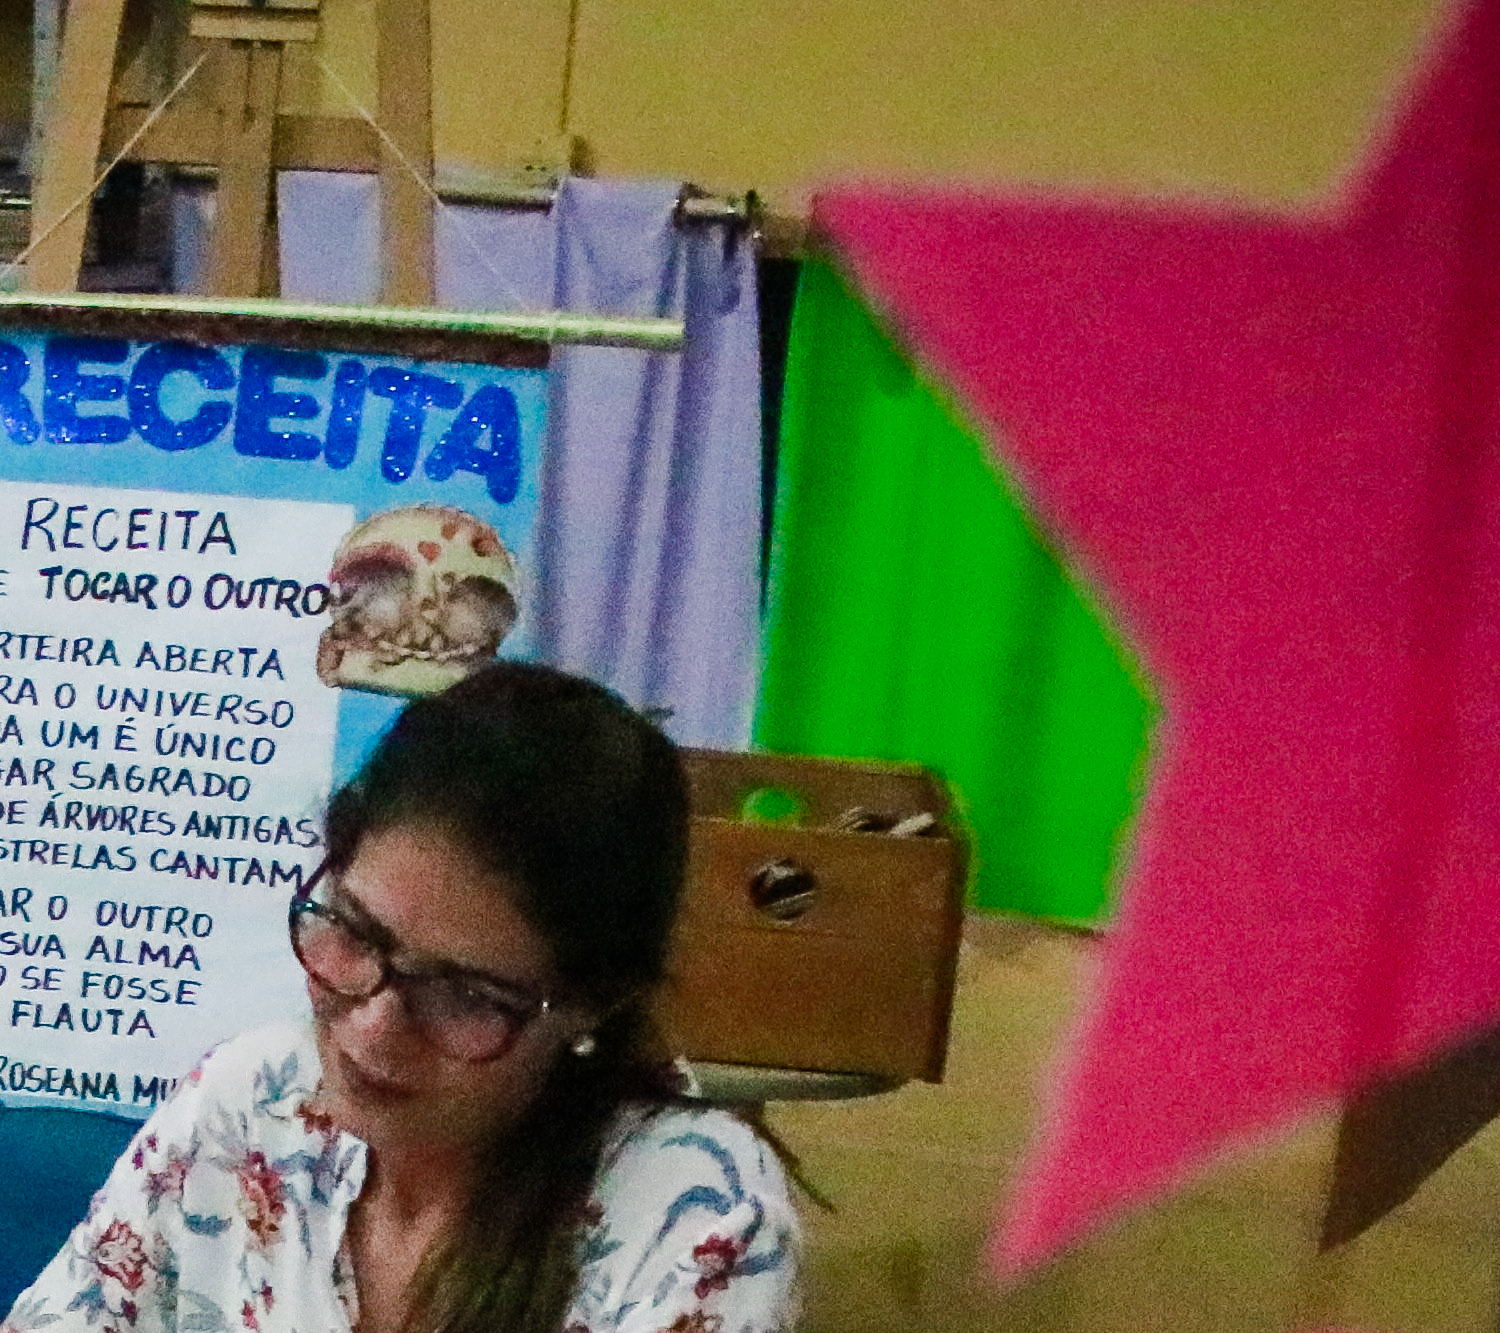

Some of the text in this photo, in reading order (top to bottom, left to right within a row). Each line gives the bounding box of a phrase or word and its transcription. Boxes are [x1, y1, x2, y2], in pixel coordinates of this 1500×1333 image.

[21, 497, 237, 555] RECEITA
[39, 566, 158, 610] TOCAR
[167, 575, 191, 608] O
[203, 573, 331, 618] OUTRO
[136, 641, 285, 681] ABERTA
[54, 683, 77, 709] O
[97, 683, 294, 729] UNIVERSO
[41, 719, 100, 751] UM
[114, 716, 138, 752] É
[155, 722, 276, 766] ÚNICO
[69, 760, 251, 802] SAGRADO
[40, 791, 176, 836] ÁRVORES
[183, 809, 321, 848] ANTIGAS
[150, 847, 303, 892] CANTAM
[48, 895, 68, 921] O
[96, 900, 214, 938] OUTRO
[85, 935, 202, 971] ALMA
[21, 965, 65, 991] SE
[81, 970, 203, 1006] FOSSE
[11, 999, 157, 1039] FLAUTA
